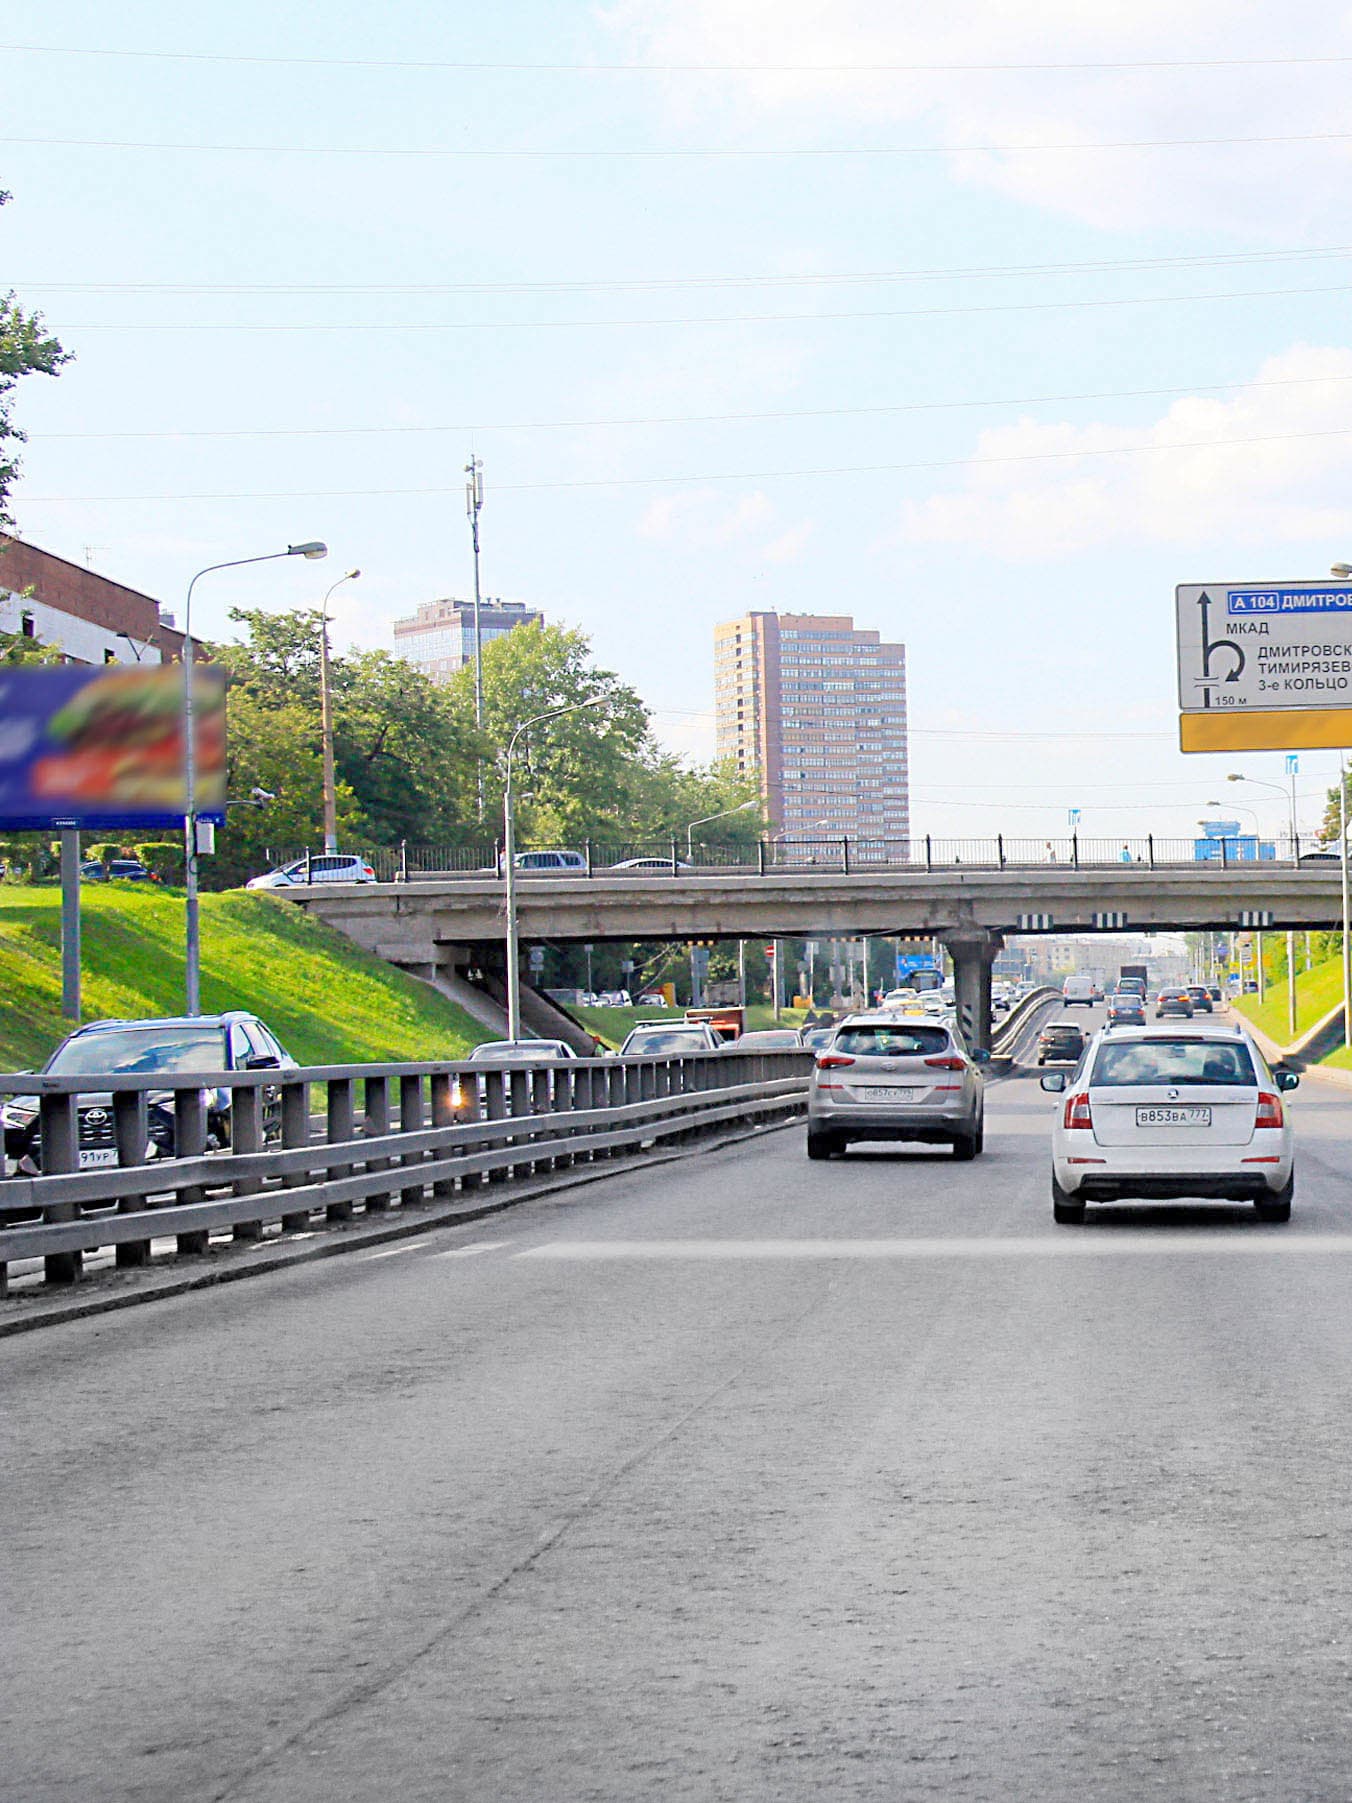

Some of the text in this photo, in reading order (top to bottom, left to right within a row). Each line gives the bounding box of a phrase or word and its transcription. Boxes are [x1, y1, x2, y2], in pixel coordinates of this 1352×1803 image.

[1250, 596, 1276, 608] 104
[1226, 622, 1269, 636] МКАД
[1258, 677, 1348, 691] 3-е КОЛЬЦО
[1215, 696, 1235, 706] 150
